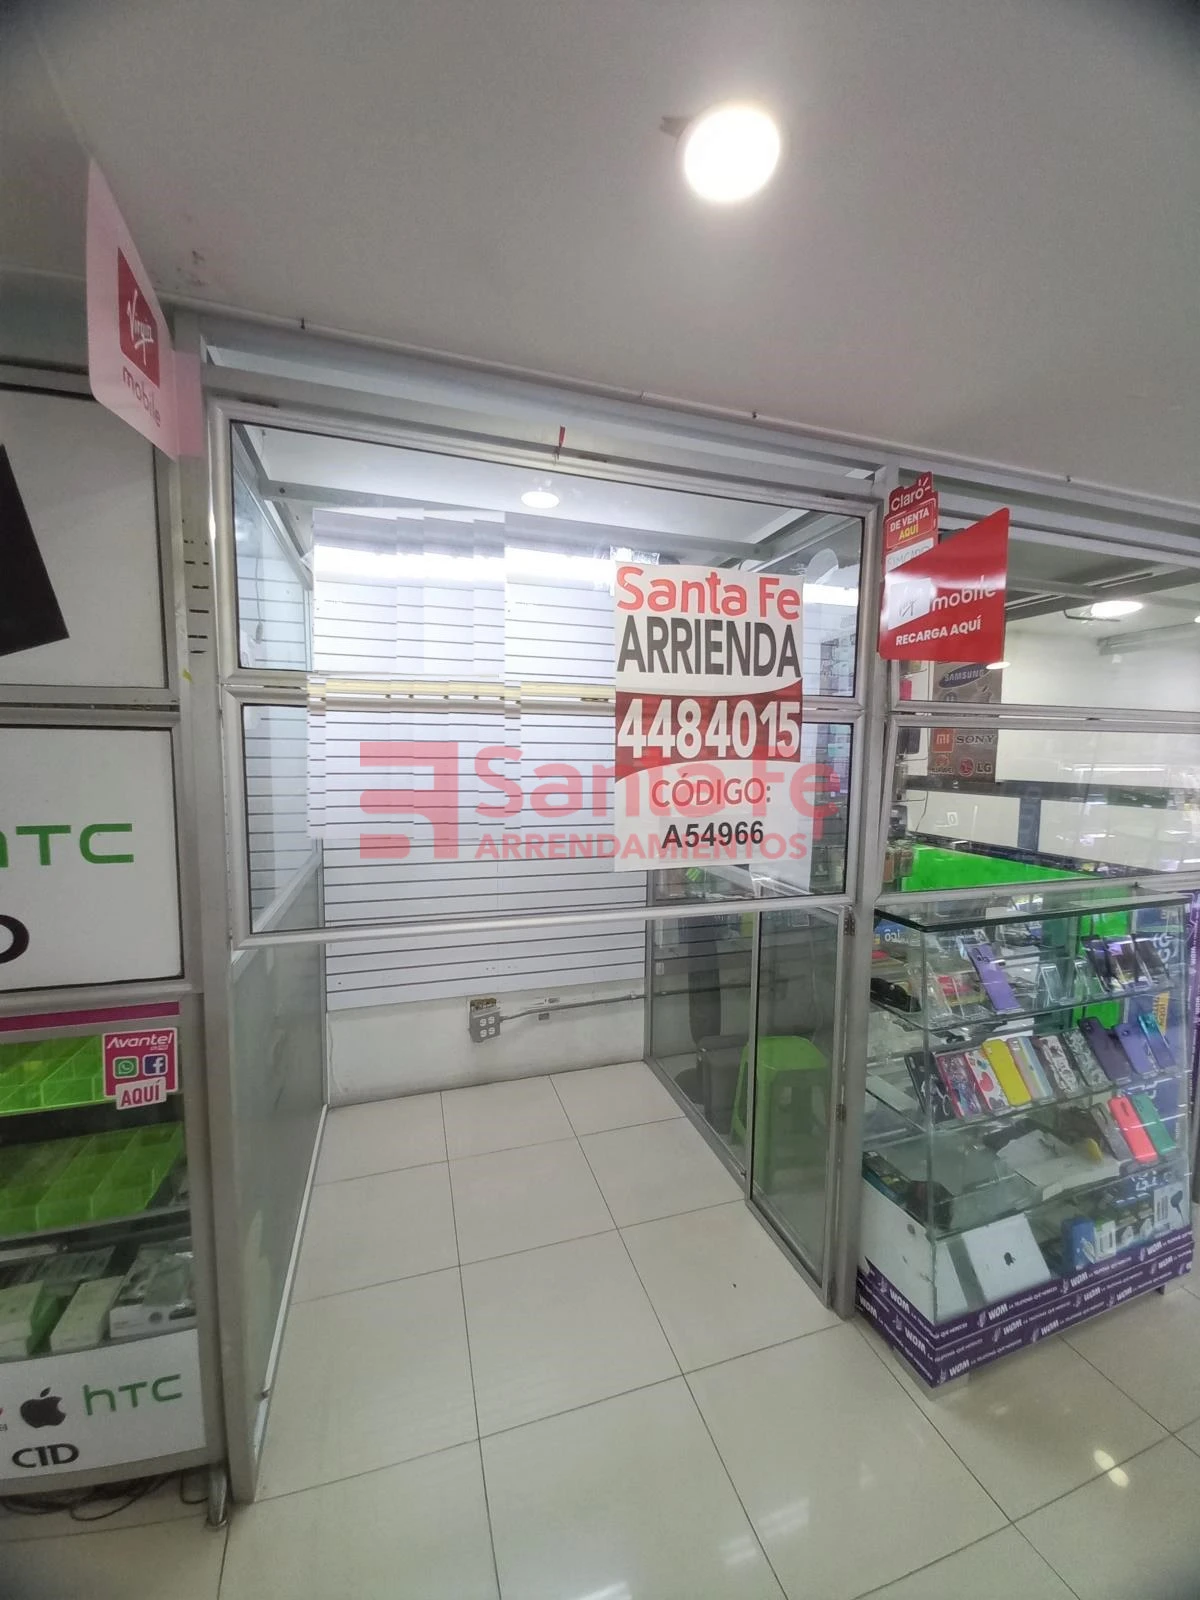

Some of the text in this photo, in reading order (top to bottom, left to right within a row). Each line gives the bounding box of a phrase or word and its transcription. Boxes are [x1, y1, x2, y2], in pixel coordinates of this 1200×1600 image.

[122, 366, 161, 428] mobile
[890, 487, 924, 511] Claro
[890, 507, 930, 533] DE VENTA
[616, 565, 801, 620] Santa Fe
[931, 574, 997, 612] mobile
[895, 614, 982, 646] RECARGA AQUÍ
[616, 614, 801, 678] ARRIENDA
[944, 669, 985, 682] SAMSUNG
[616, 698, 801, 760] 4484015
[956, 734, 994, 745] SONY
[977, 763, 992, 773] LG
[651, 772, 771, 809] CÓDIGO:
[661, 820, 765, 849] A54966
[106, 1031, 174, 1050] Avantel
[120, 1078, 161, 1107] AQUÍ
[889, 1288, 911, 1315] WOM
[987, 1303, 1009, 1321] WOM
[904, 1326, 927, 1355] WOM
[948, 1359, 971, 1378] WOM
[11, 1442, 80, 1469] CID
